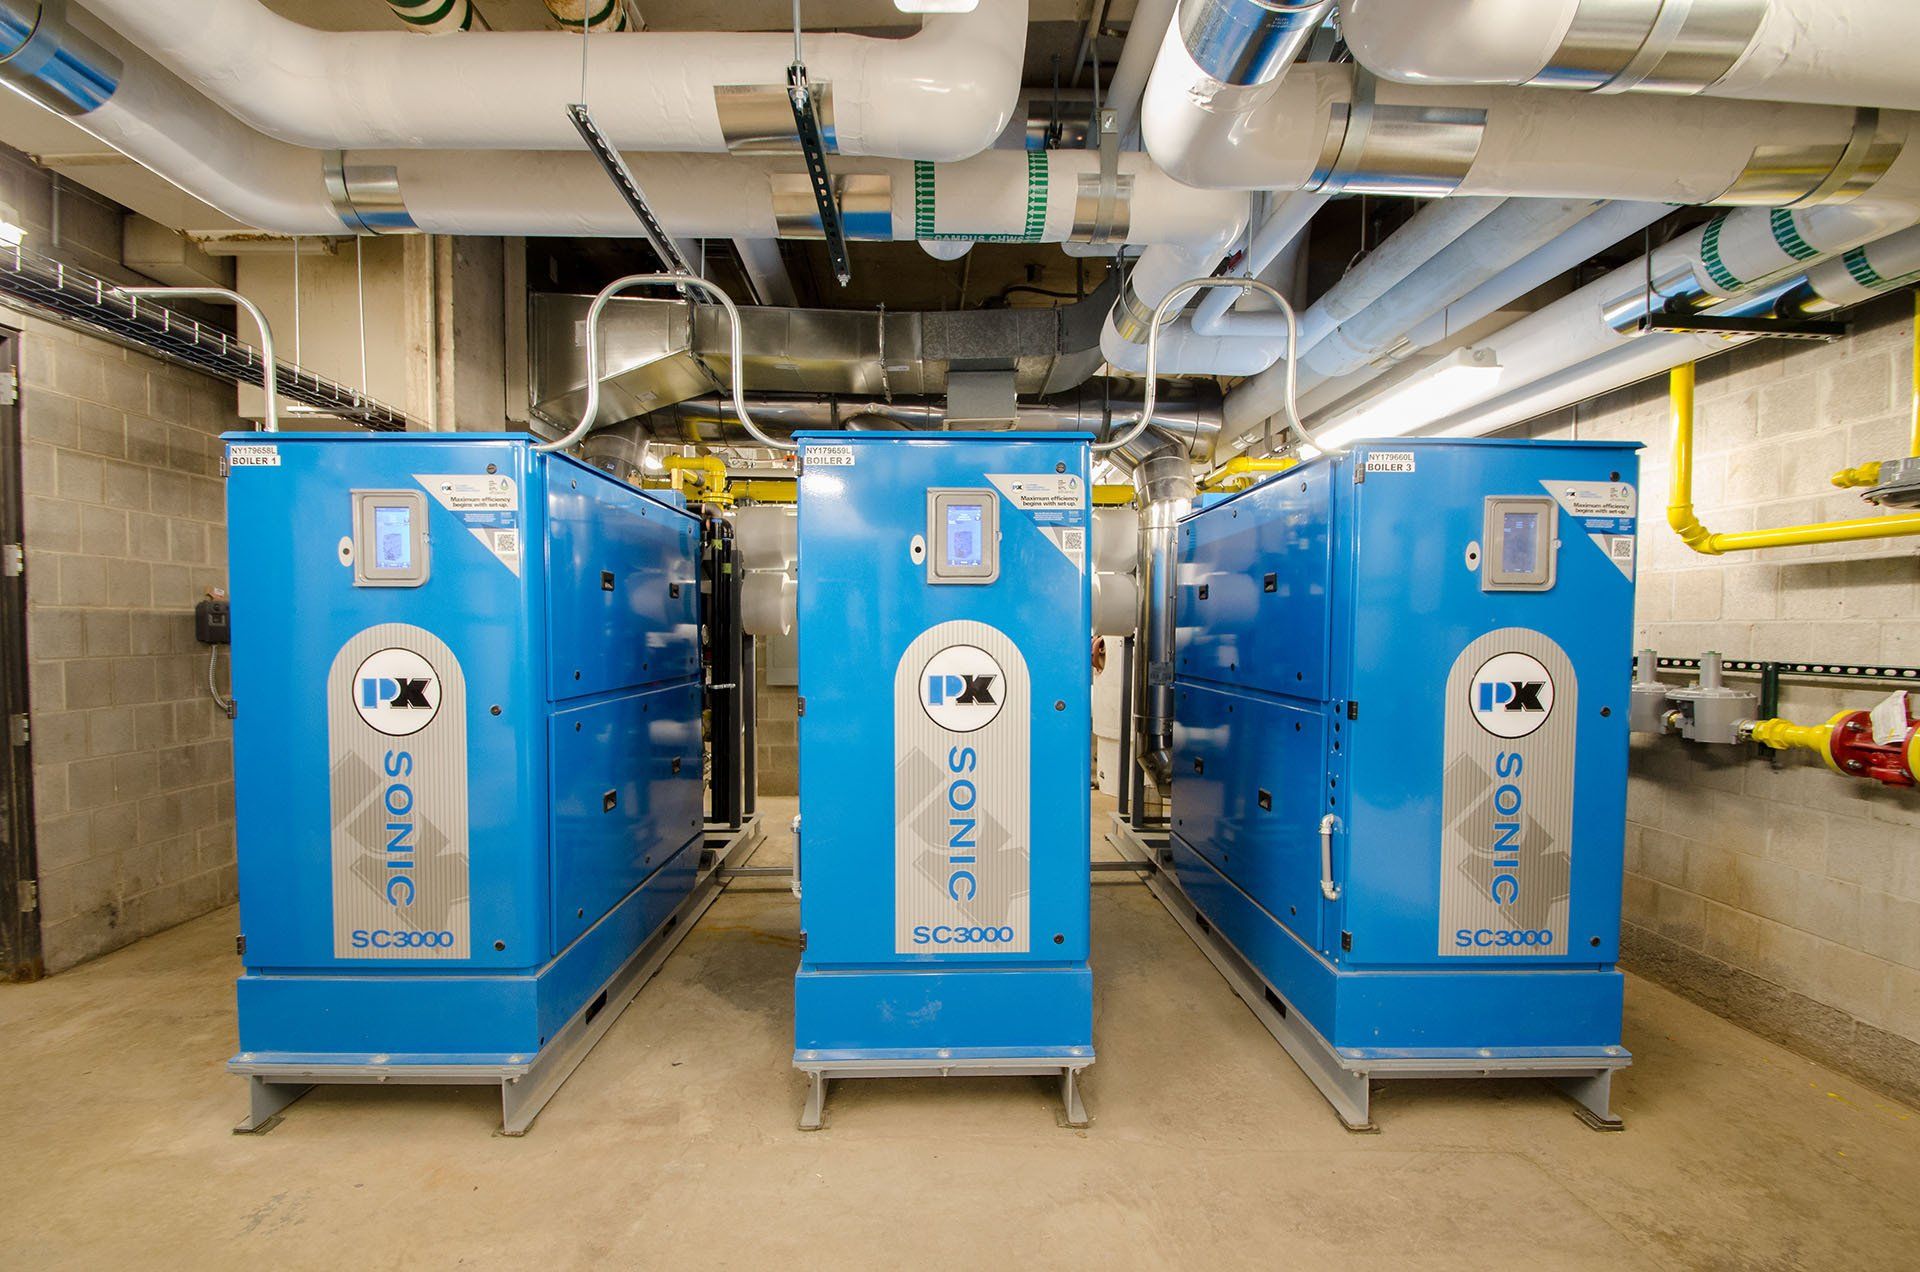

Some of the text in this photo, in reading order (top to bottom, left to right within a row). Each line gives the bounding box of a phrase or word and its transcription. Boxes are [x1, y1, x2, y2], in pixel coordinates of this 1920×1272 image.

[361, 677, 432, 710] PK
[928, 674, 998, 706] PK
[1478, 681, 1546, 712] PK
[384, 749, 416, 907] SONIC
[948, 745, 977, 902] SONIC
[1492, 751, 1523, 905] SONIC
[352, 930, 454, 948] SC3000
[913, 926, 1014, 944] SC3000
[1455, 929, 1553, 947] SC3000
